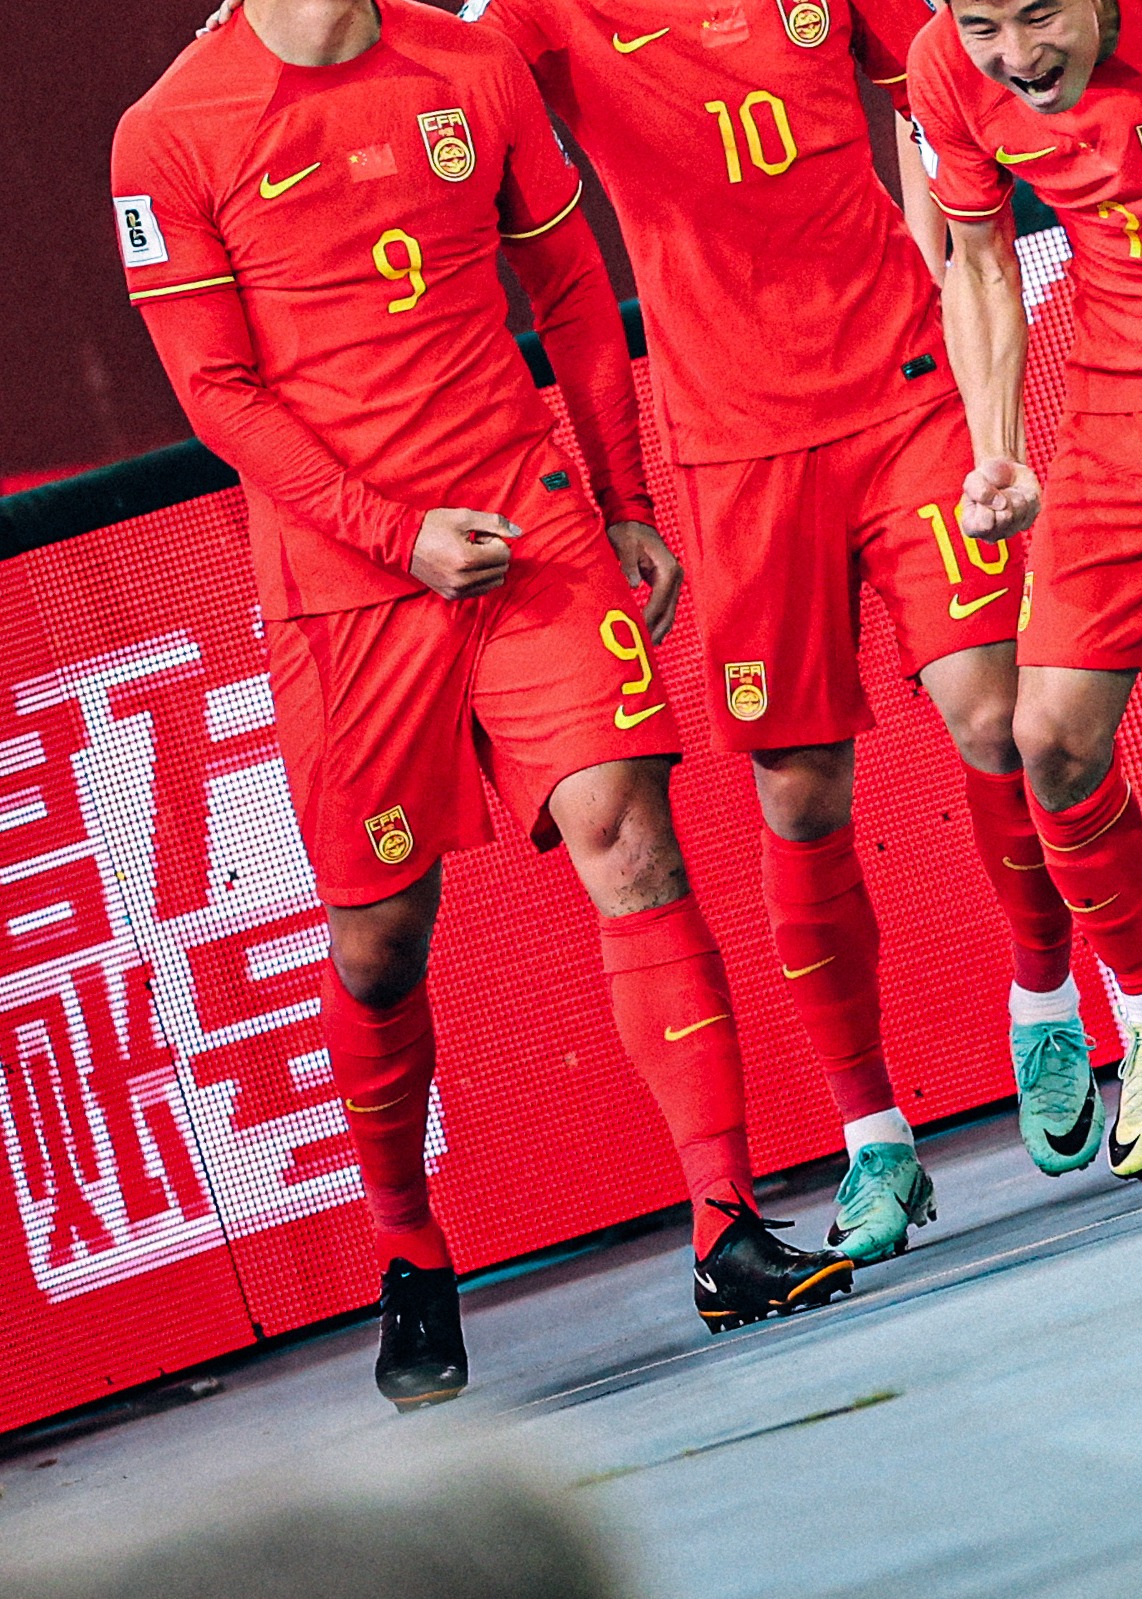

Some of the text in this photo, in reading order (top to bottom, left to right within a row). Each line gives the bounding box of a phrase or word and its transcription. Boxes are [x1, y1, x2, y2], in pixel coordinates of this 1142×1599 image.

[423, 113, 463, 132] CFA
[704, 90, 798, 183] 10
[1097, 201, 1142, 259] 7
[372, 228, 426, 314] 9
[916, 495, 1009, 585] 10
[600, 609, 653, 695] 9
[729, 665, 761, 678] CFA
[369, 811, 402, 831] CFA
